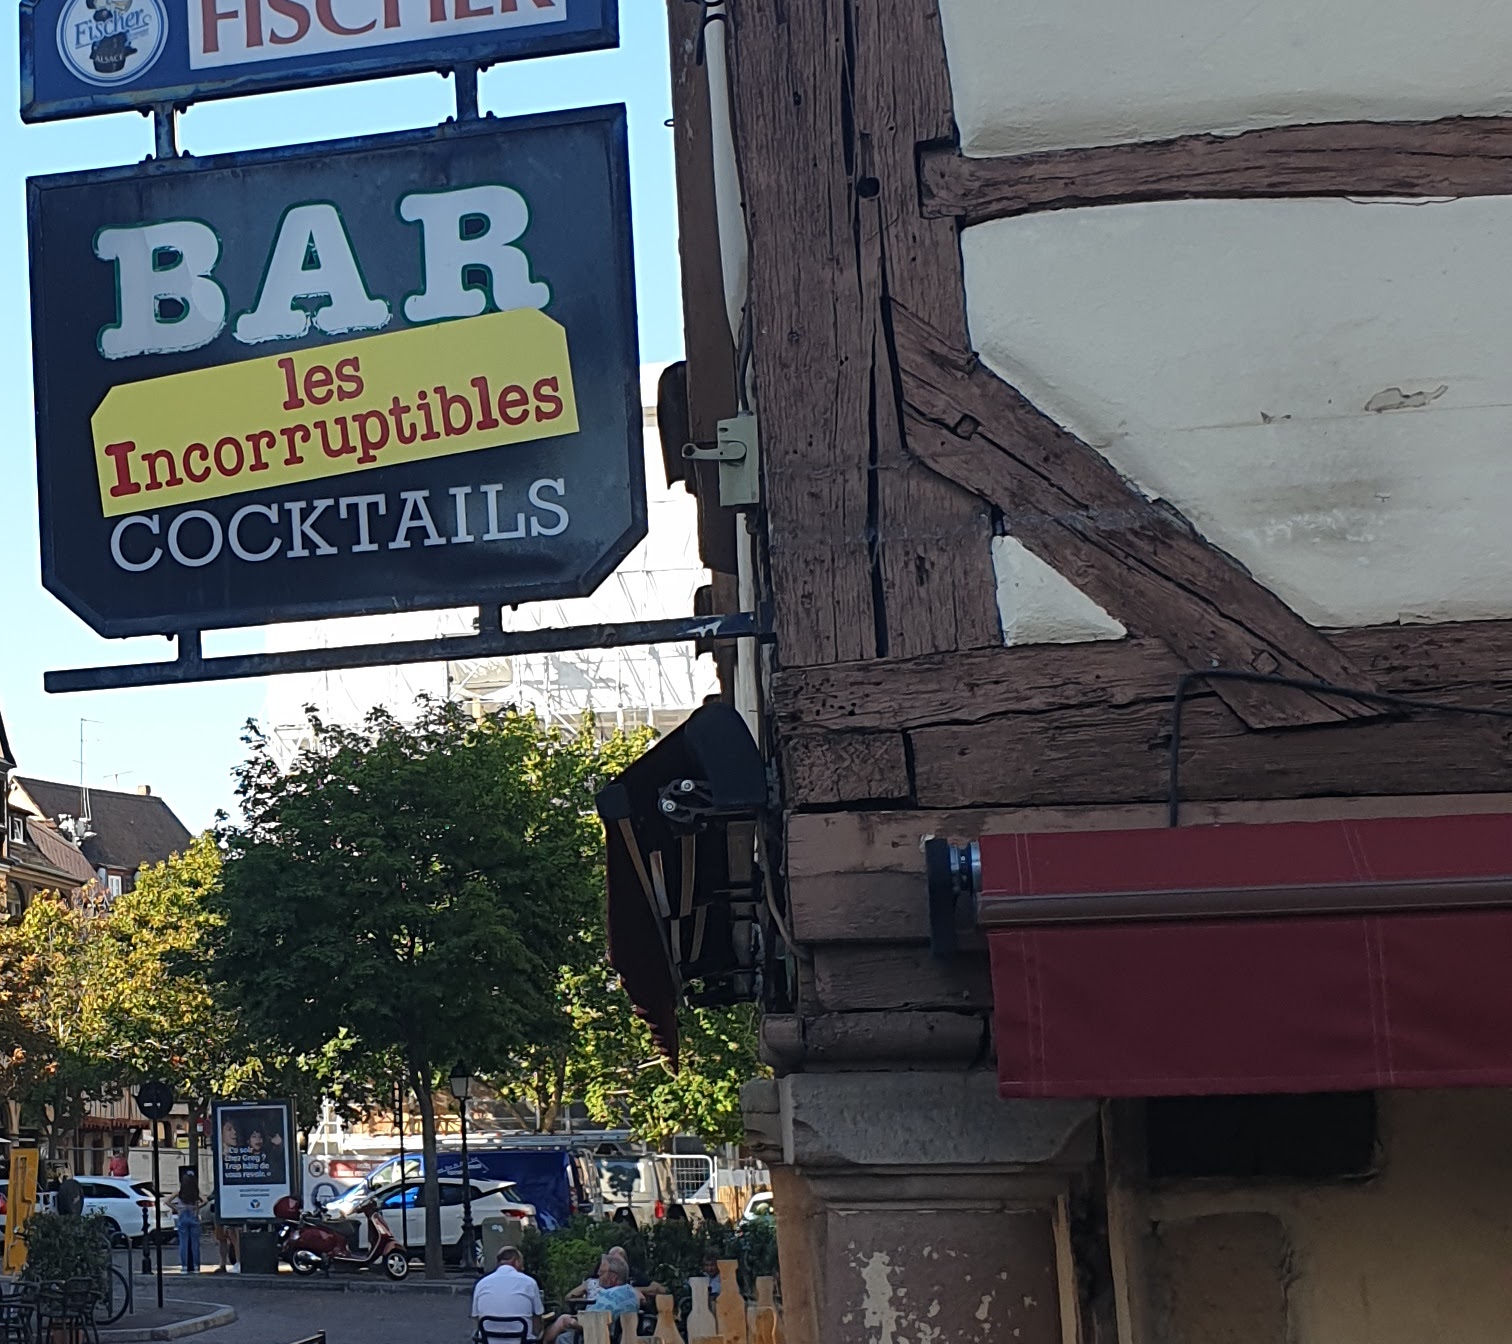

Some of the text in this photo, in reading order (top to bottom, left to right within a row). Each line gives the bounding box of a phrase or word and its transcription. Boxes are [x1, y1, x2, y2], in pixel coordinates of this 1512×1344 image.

[74, 8, 144, 49] Fischer
[93, 184, 554, 360] BAR
[278, 356, 364, 412] les
[104, 375, 564, 498] Incorruptibles
[110, 478, 570, 572] COCKTAILS
